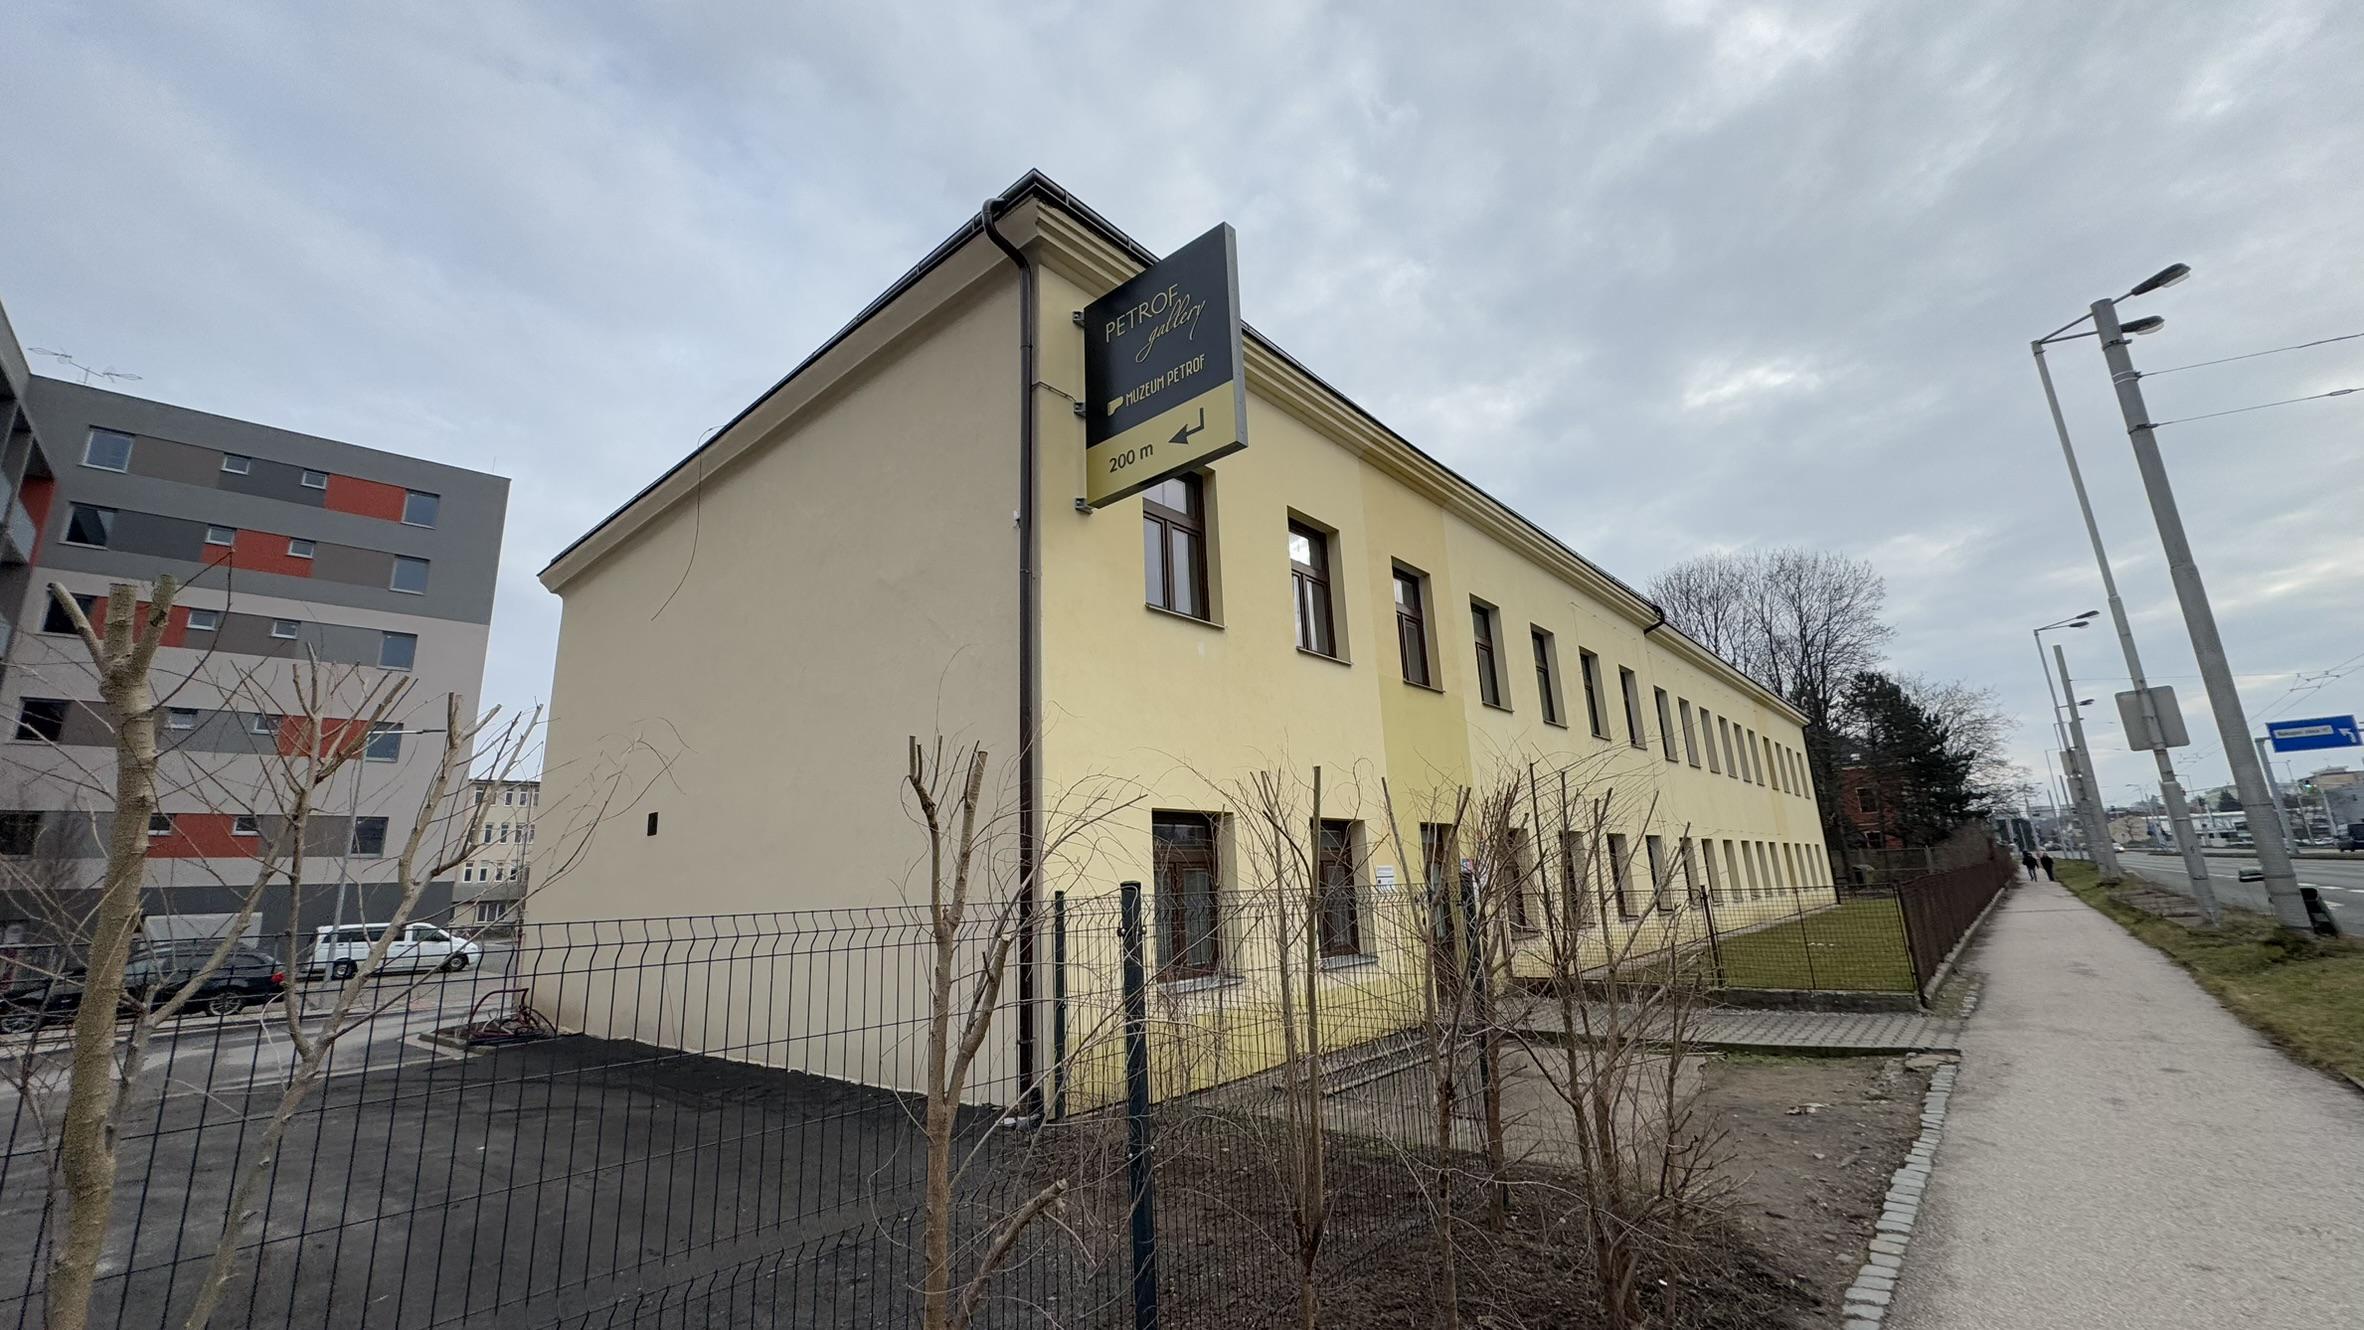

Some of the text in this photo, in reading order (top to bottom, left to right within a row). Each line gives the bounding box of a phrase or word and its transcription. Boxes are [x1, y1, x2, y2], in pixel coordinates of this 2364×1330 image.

[1106, 283, 1178, 343] PETROF
[1135, 293, 1206, 363] gallery
[1125, 353, 1205, 406] MUZEUM PETROF
[1109, 443, 1154, 473] 200 m
